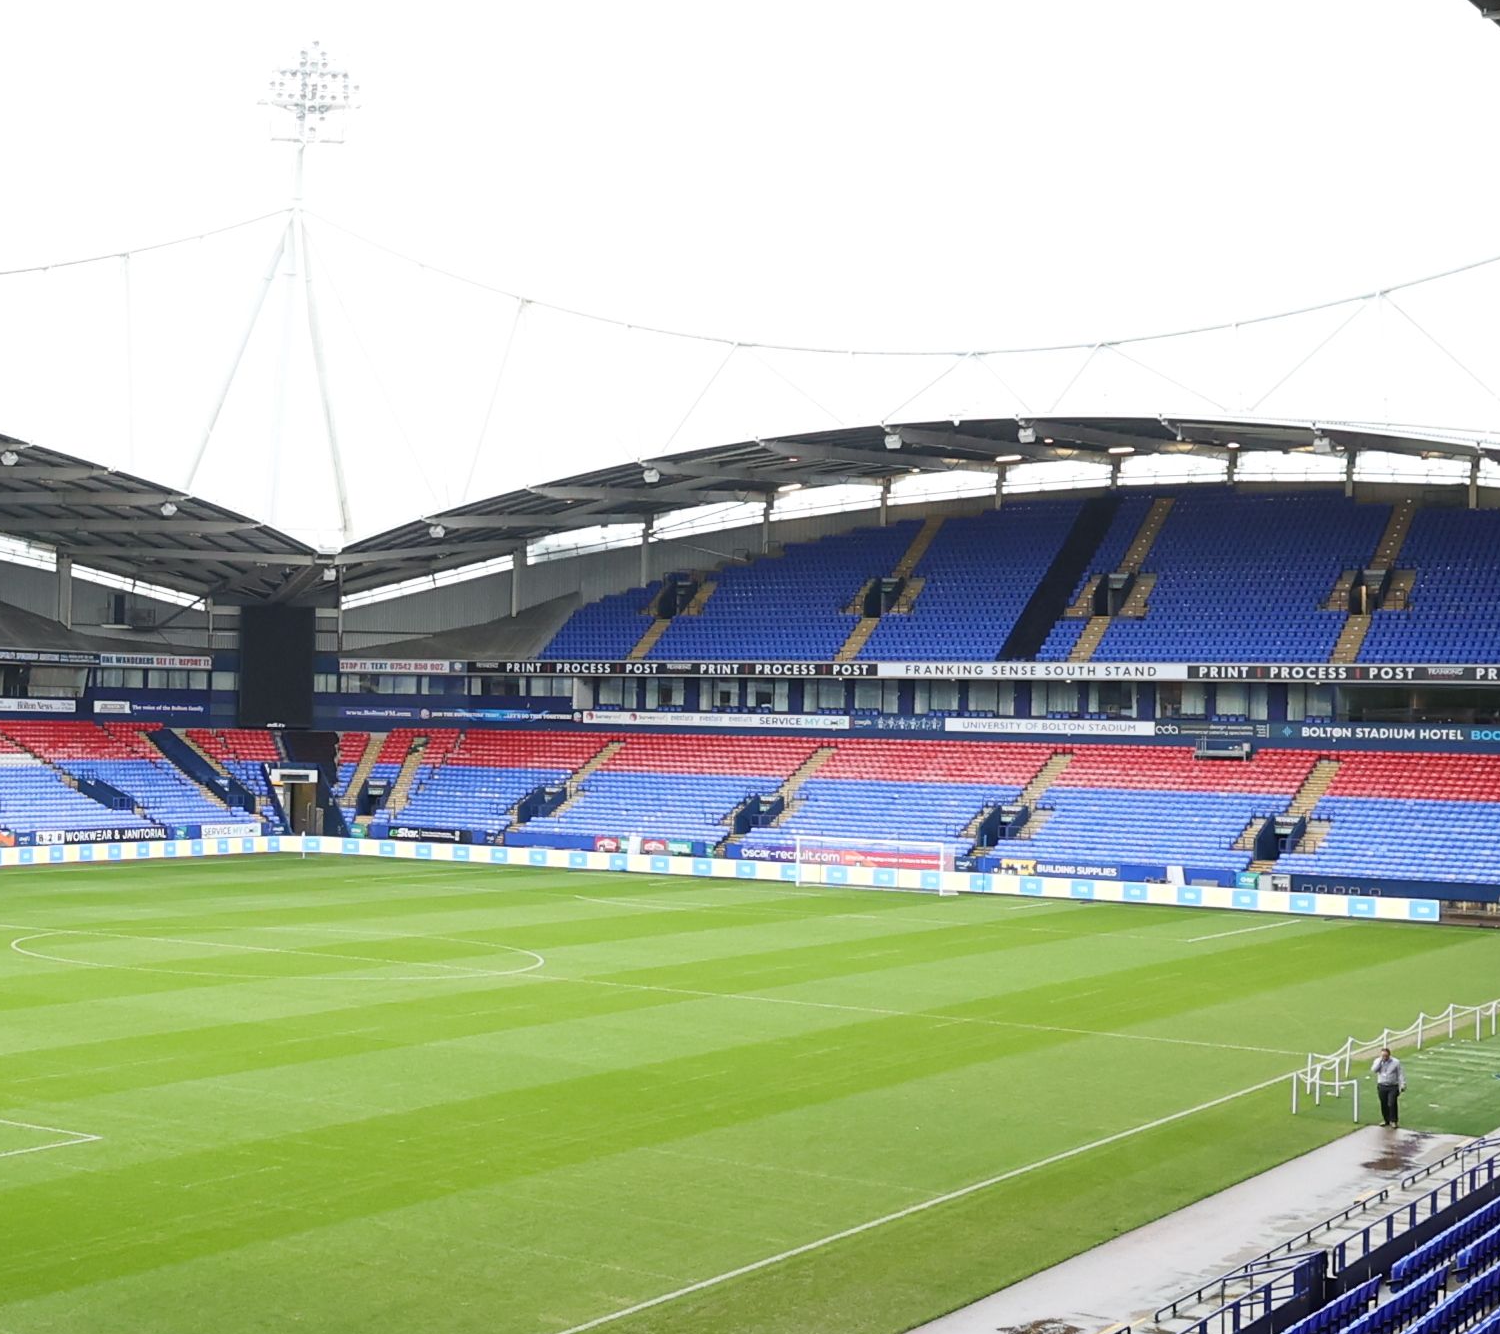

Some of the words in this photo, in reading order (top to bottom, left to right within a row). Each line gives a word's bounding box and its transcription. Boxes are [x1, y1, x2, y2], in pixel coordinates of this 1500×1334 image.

[506, 663, 541, 673] PRINT
[556, 663, 611, 673] PROCESS
[625, 663, 658, 674] POST
[700, 664, 739, 675] PRINT
[755, 664, 816, 675] PROCESS
[833, 664, 869, 676] POST
[905, 665, 984, 675] FRANKING
[992, 665, 1037, 676] SENSE
[1045, 666, 1096, 677] SOUTH
[1105, 666, 1157, 677] STAND
[1199, 667, 1249, 678] PRINT
[1270, 667, 1347, 679] PROCESS
[1369, 668, 1415, 679] POST
[760, 716, 802, 726] SERVICE
[804, 717, 821, 727] MY
[962, 721, 1022, 731] UNIVERSITY
[1024, 722, 1040, 732] OF
[1042, 722, 1086, 732] BOLTON
[1089, 723, 1137, 733] STADIUM
[1302, 726, 1352, 738] BOLTON
[1355, 727, 1416, 740] STADIUM
[1420, 728, 1464, 741] HOTEL
[65, 829, 112, 843] WORKWEAR
[122, 827, 167, 840] JANITORIAL
[1037, 864, 1074, 874] BUILDING
[1076, 865, 1117, 877] SUPPLIES
